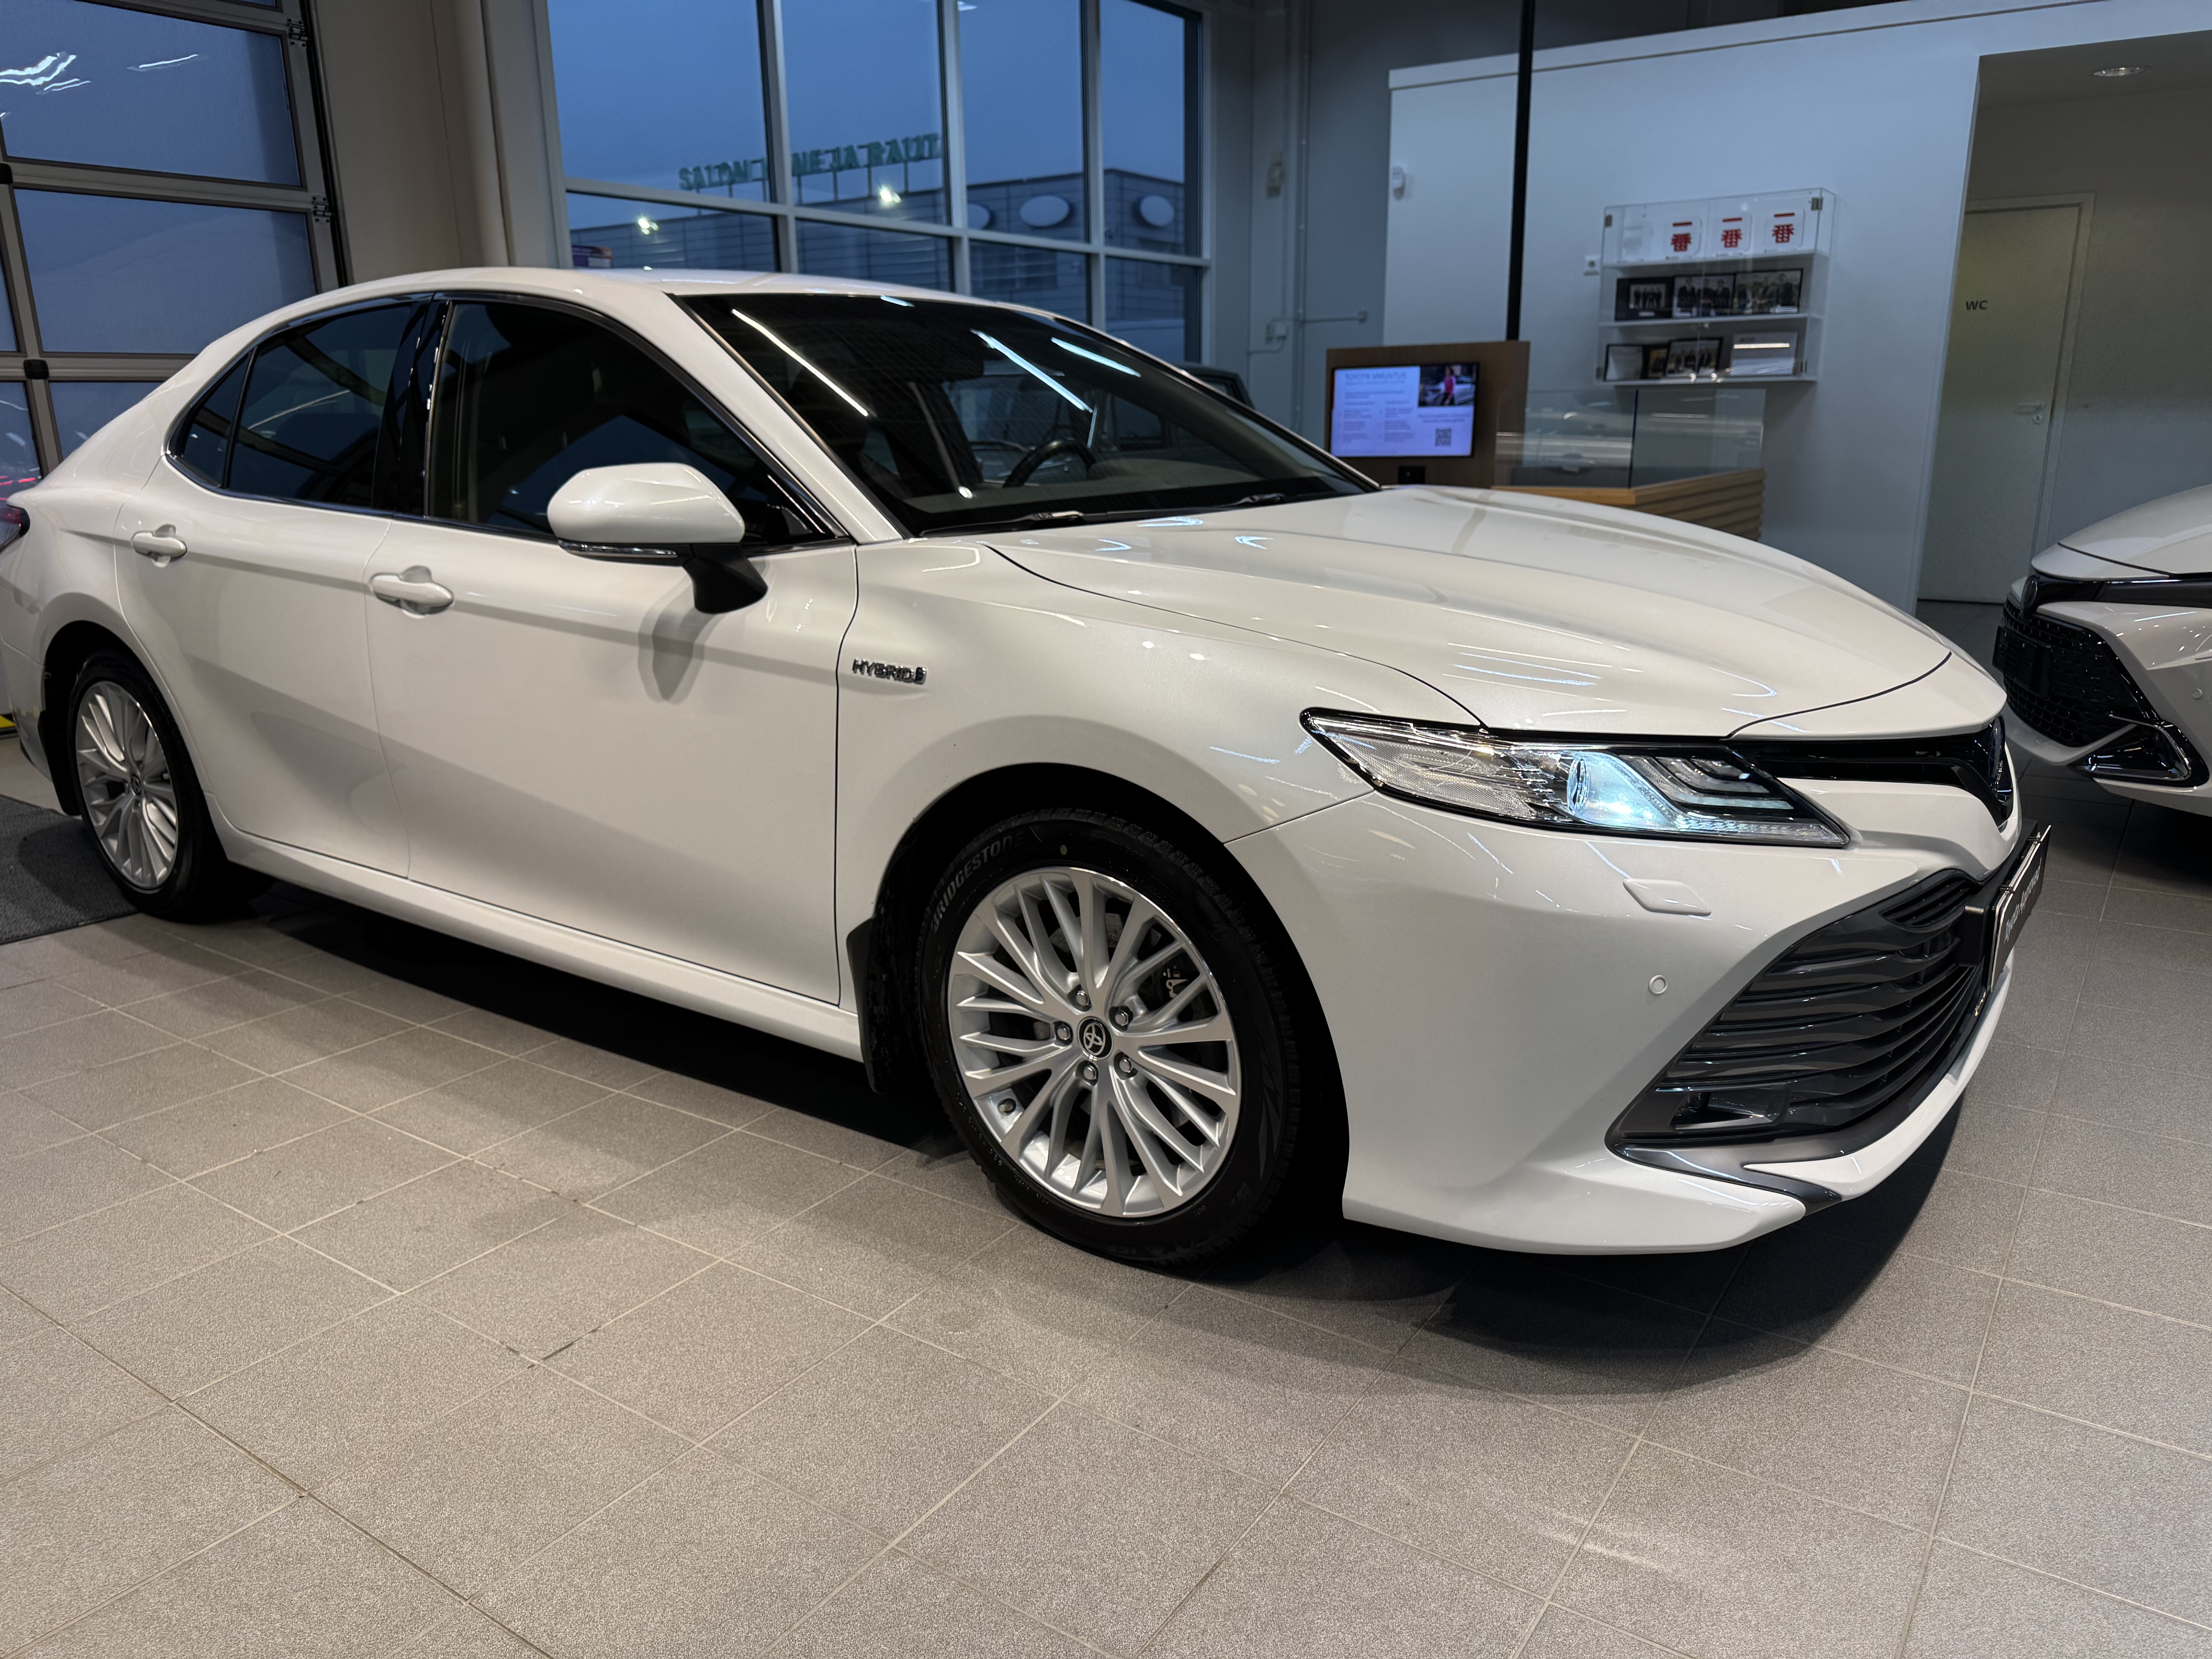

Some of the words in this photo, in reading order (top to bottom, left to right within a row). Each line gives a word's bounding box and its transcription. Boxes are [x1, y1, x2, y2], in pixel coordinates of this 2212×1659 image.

[679, 159, 748, 191] SALON
[867, 132, 943, 167] RAUT
[1966, 300, 1987, 310] WC
[852, 659, 914, 683] HYBRID
[930, 831, 1025, 934] BRIDGESTONE
